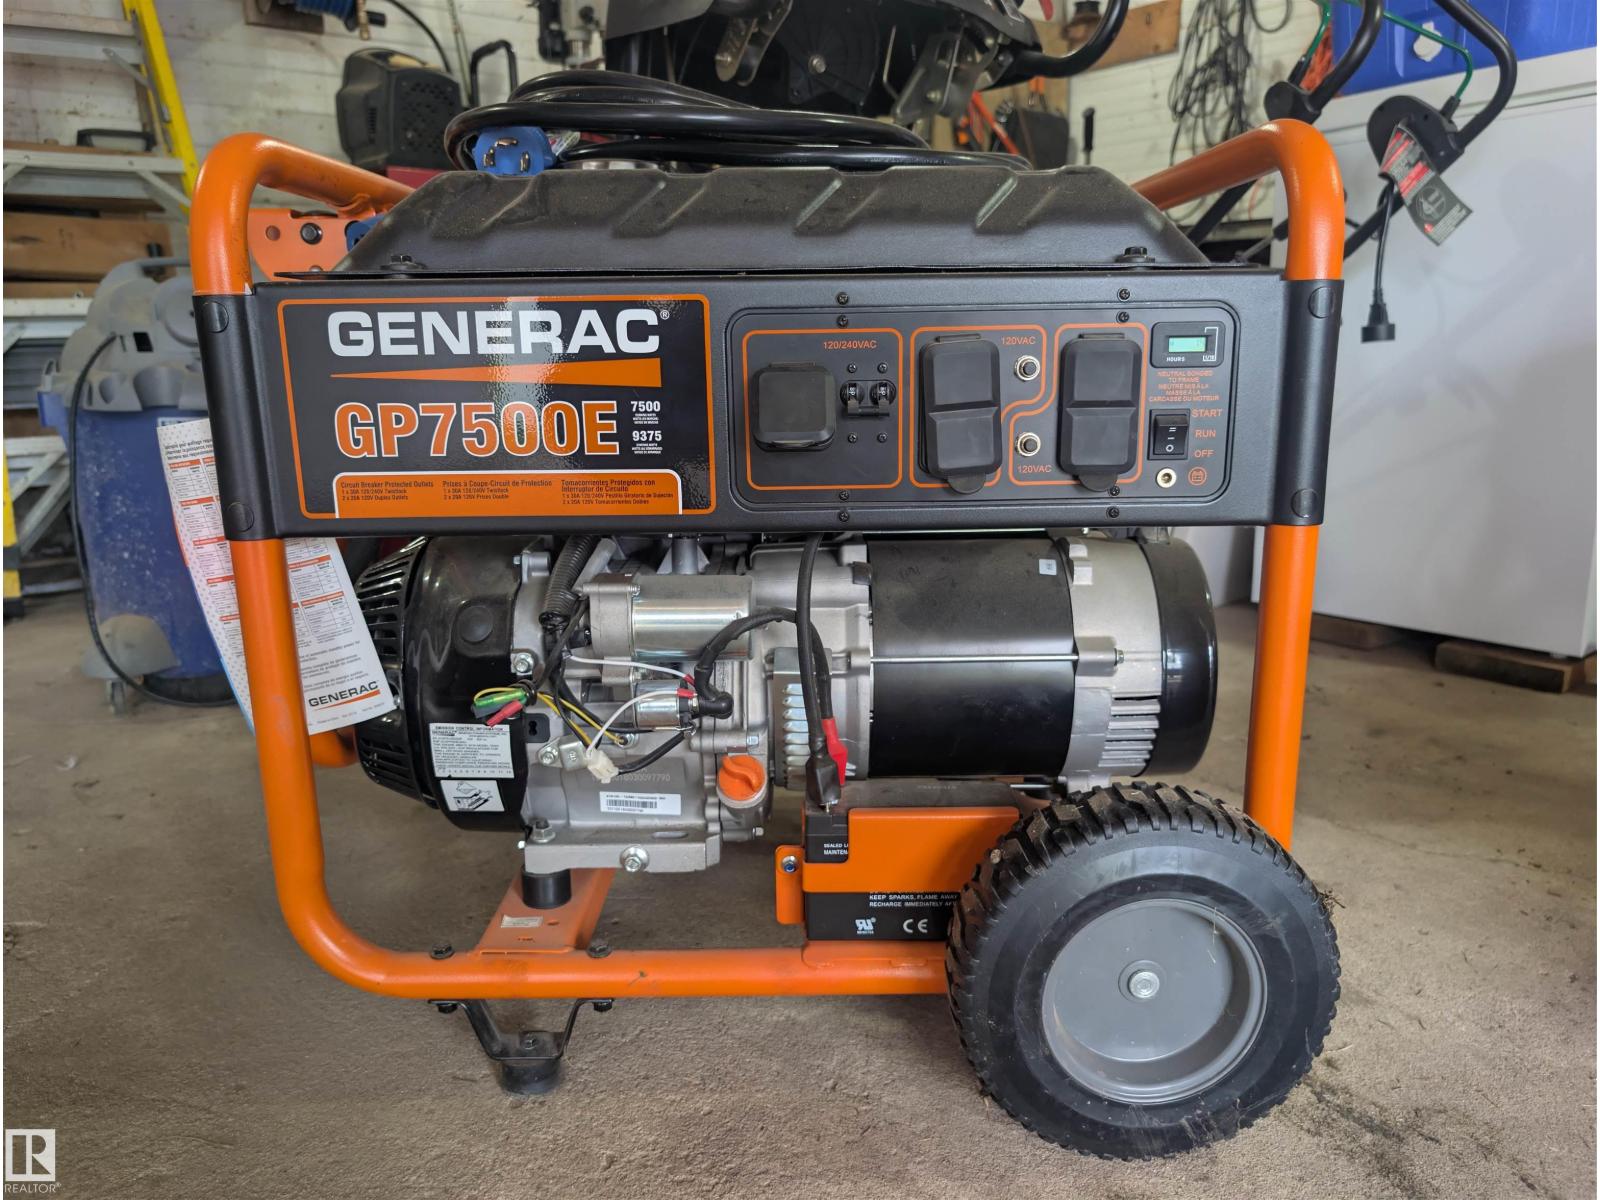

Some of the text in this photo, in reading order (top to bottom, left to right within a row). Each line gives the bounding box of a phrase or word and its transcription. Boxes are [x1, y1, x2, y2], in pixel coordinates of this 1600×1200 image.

[823, 340, 877, 350] 120/240VAC
[1002, 336, 1036, 345] 120VAC
[630, 400, 660, 412] 7500
[1192, 408, 1222, 418] START
[334, 400, 620, 458] GP7500E
[1195, 430, 1216, 438] RUN
[632, 430, 662, 441] 9375
[1194, 450, 1214, 458] OFF
[1017, 464, 1052, 474] 120VAC
[308, 681, 378, 707] GENERAC
[903, 918, 928, 934] CE
